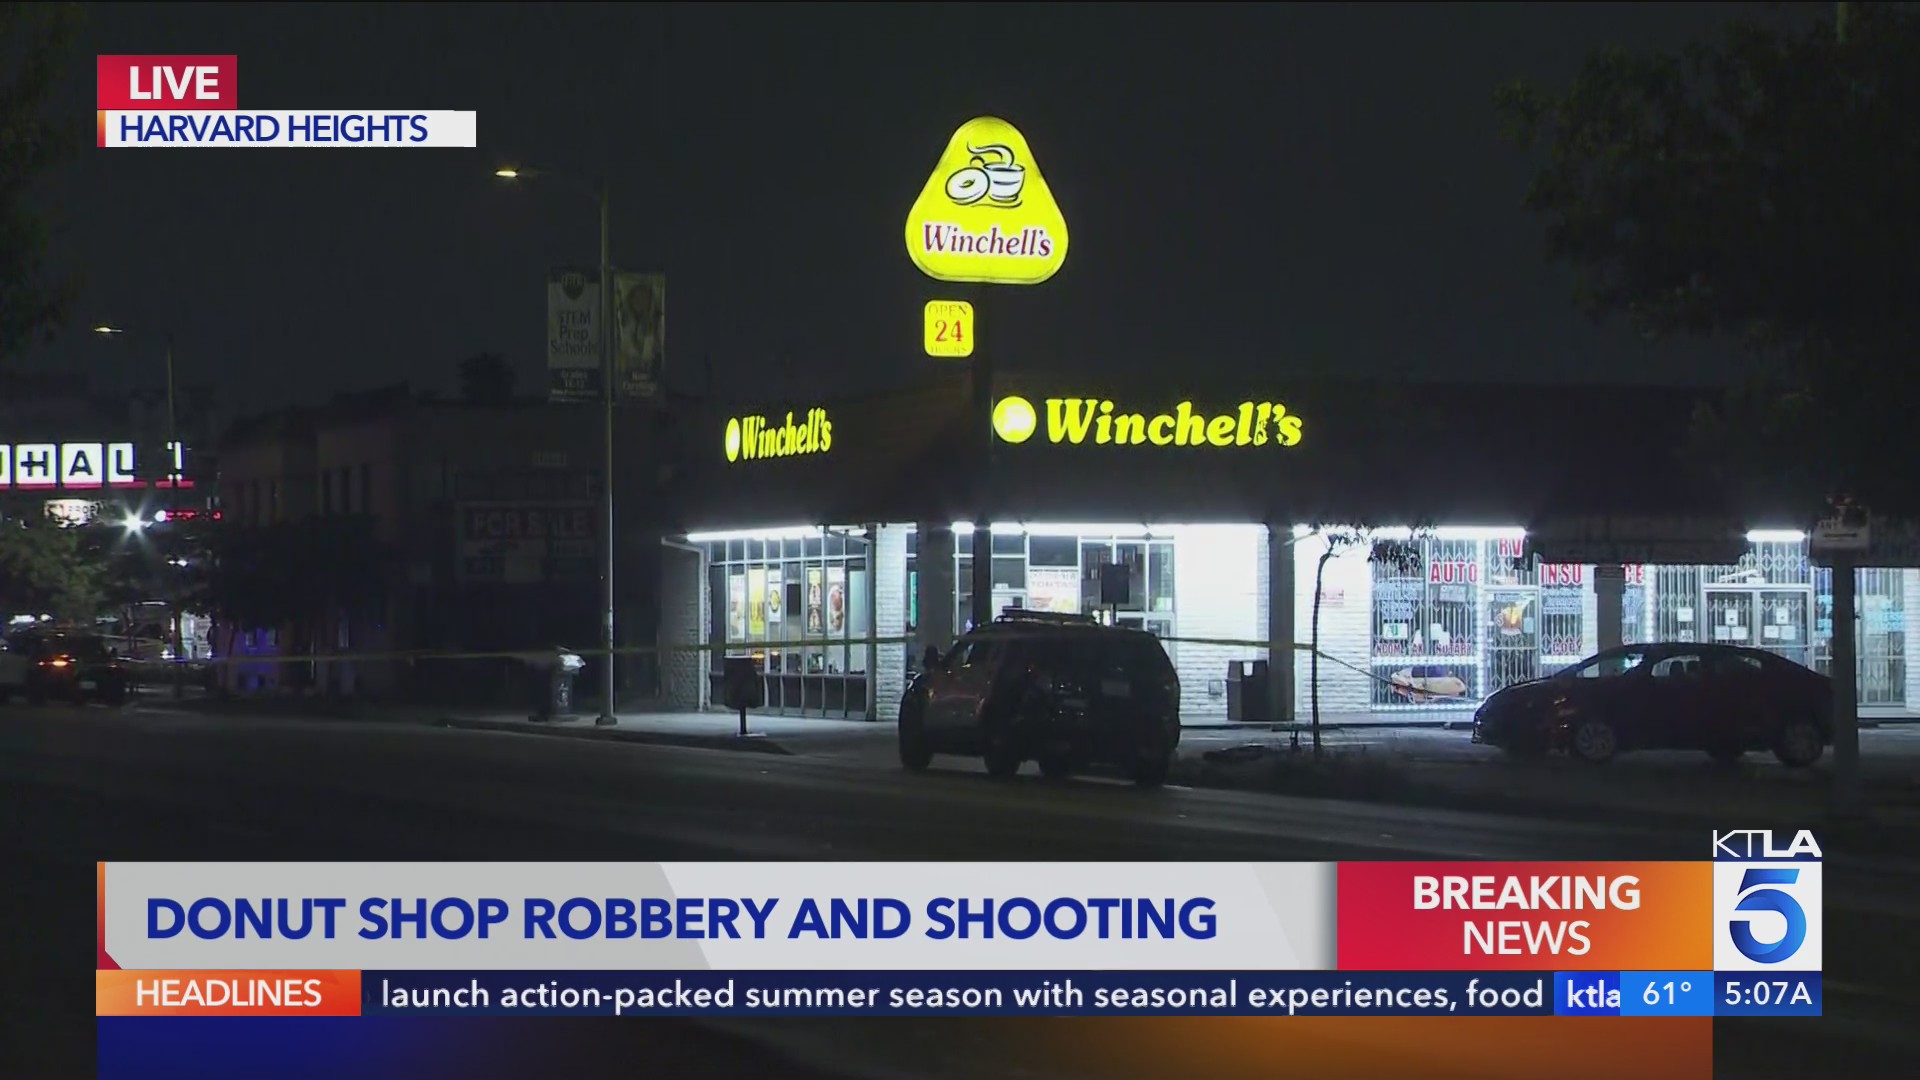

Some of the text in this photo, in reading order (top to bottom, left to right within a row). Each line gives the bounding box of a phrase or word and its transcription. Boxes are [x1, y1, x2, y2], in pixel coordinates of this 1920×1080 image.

[924, 224, 1051, 257] Winchell's
[929, 303, 968, 317] OPEN
[934, 319, 965, 343] 24
[742, 407, 832, 460] Winchell's
[1045, 398, 1303, 447] Winchell's
[1430, 562, 1478, 583] AUTO
[1541, 563, 1643, 584] INSUCE
